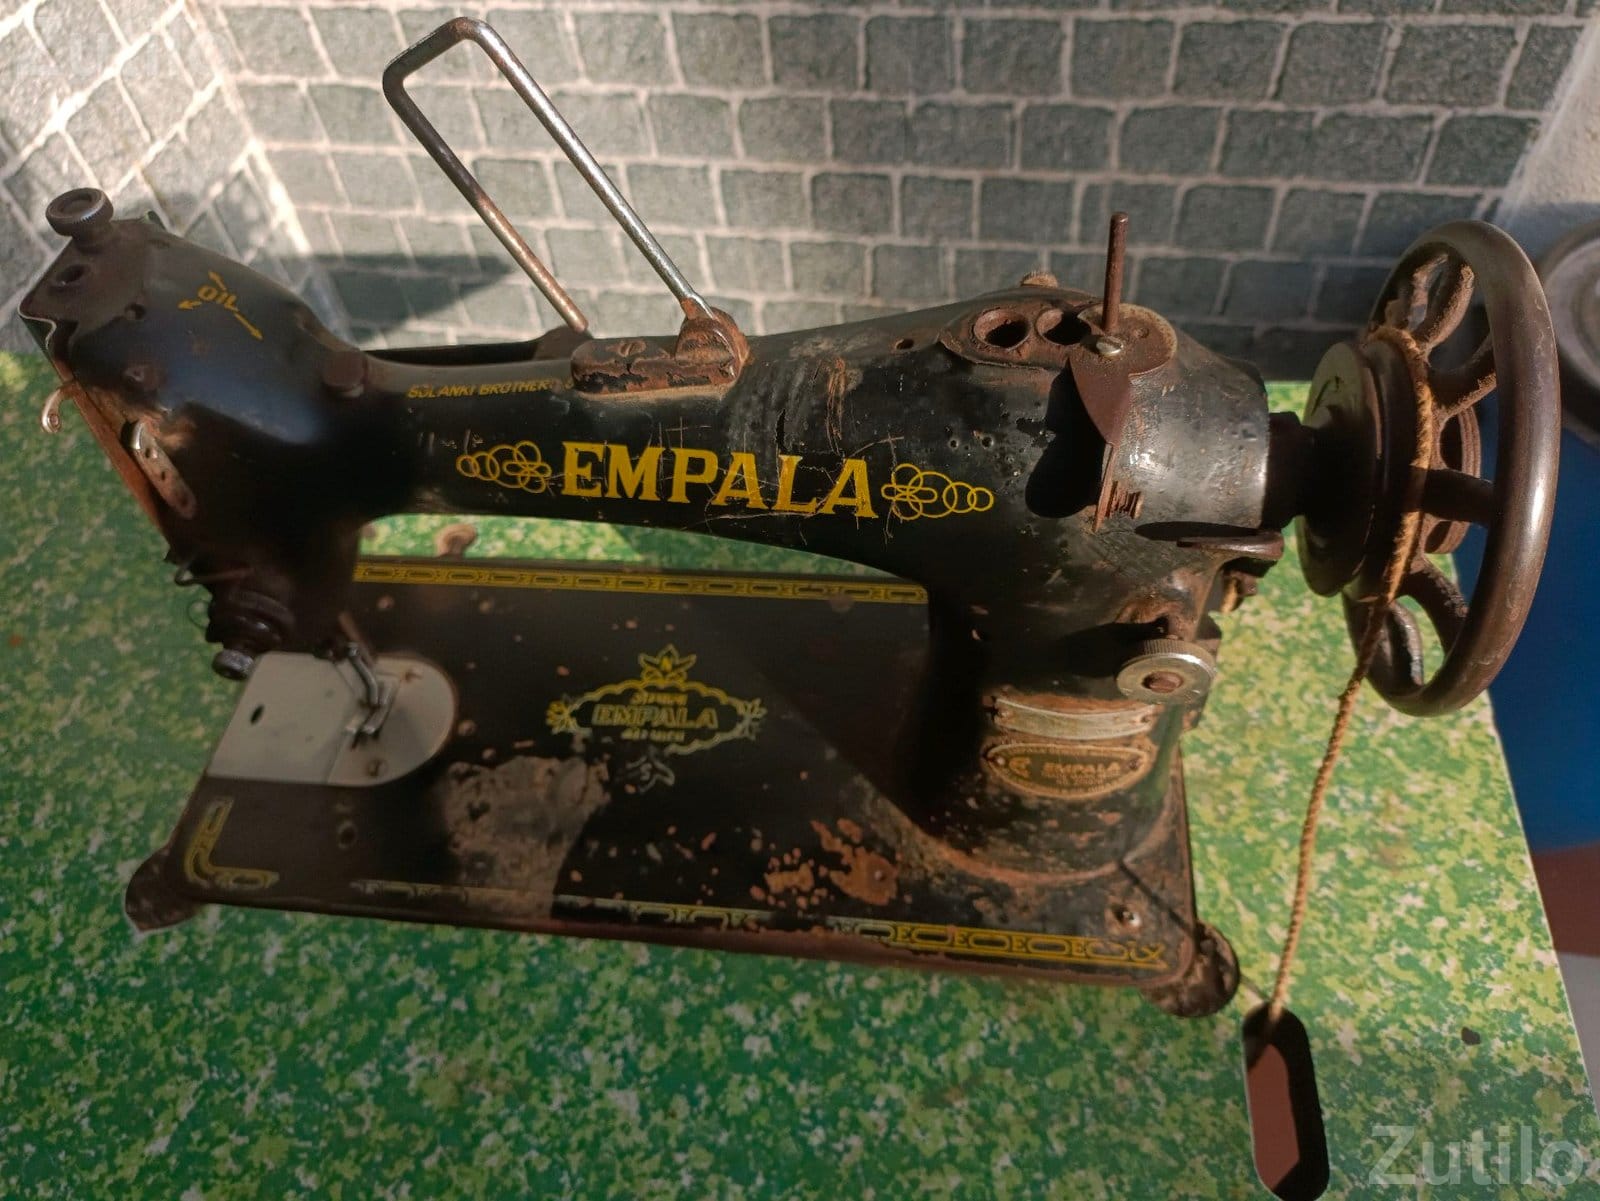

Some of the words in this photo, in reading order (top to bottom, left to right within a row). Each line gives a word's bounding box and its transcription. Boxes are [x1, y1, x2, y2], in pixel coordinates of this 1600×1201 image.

[197, 285, 239, 312] OIL
[407, 382, 476, 399] SOLANKI
[561, 440, 879, 519] EMPALA
[591, 703, 719, 730] EMPALA
